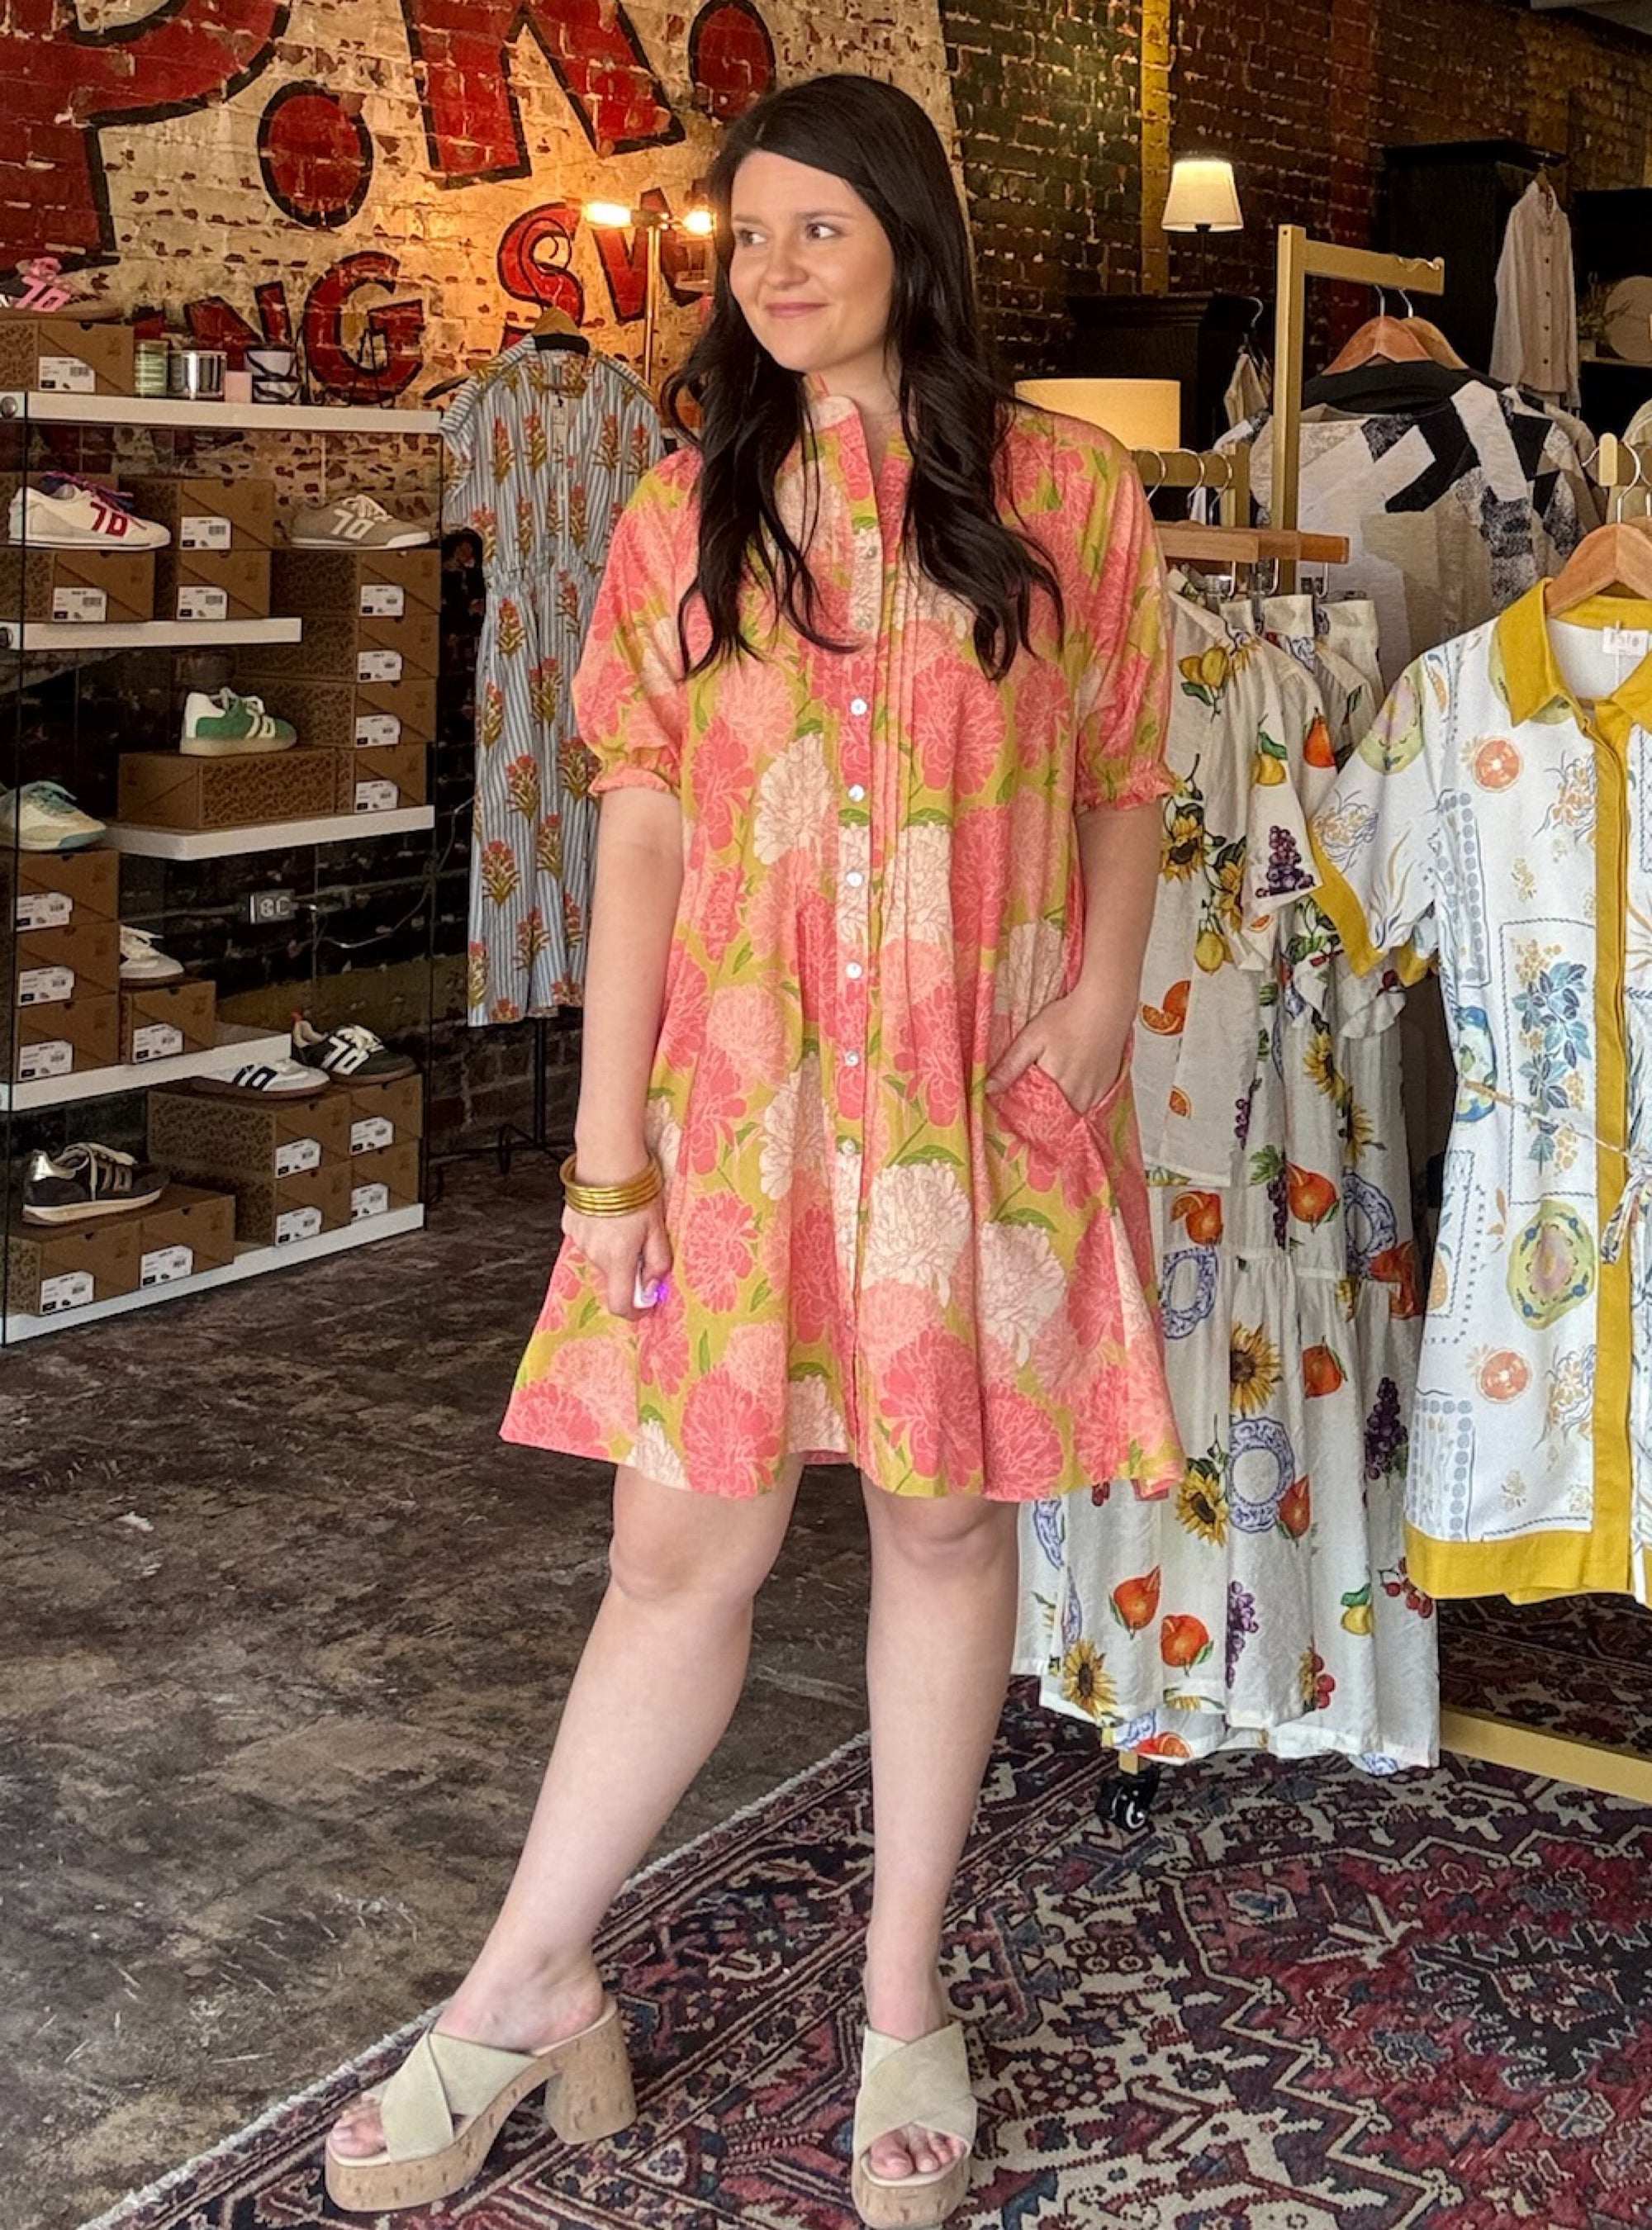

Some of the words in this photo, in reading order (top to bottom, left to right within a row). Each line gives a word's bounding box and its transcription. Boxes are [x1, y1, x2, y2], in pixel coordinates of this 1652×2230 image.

[15, 276, 71, 311] 70
[90, 501, 128, 537] 70
[330, 508, 376, 539] 70
[320, 1036, 370, 1075] 70
